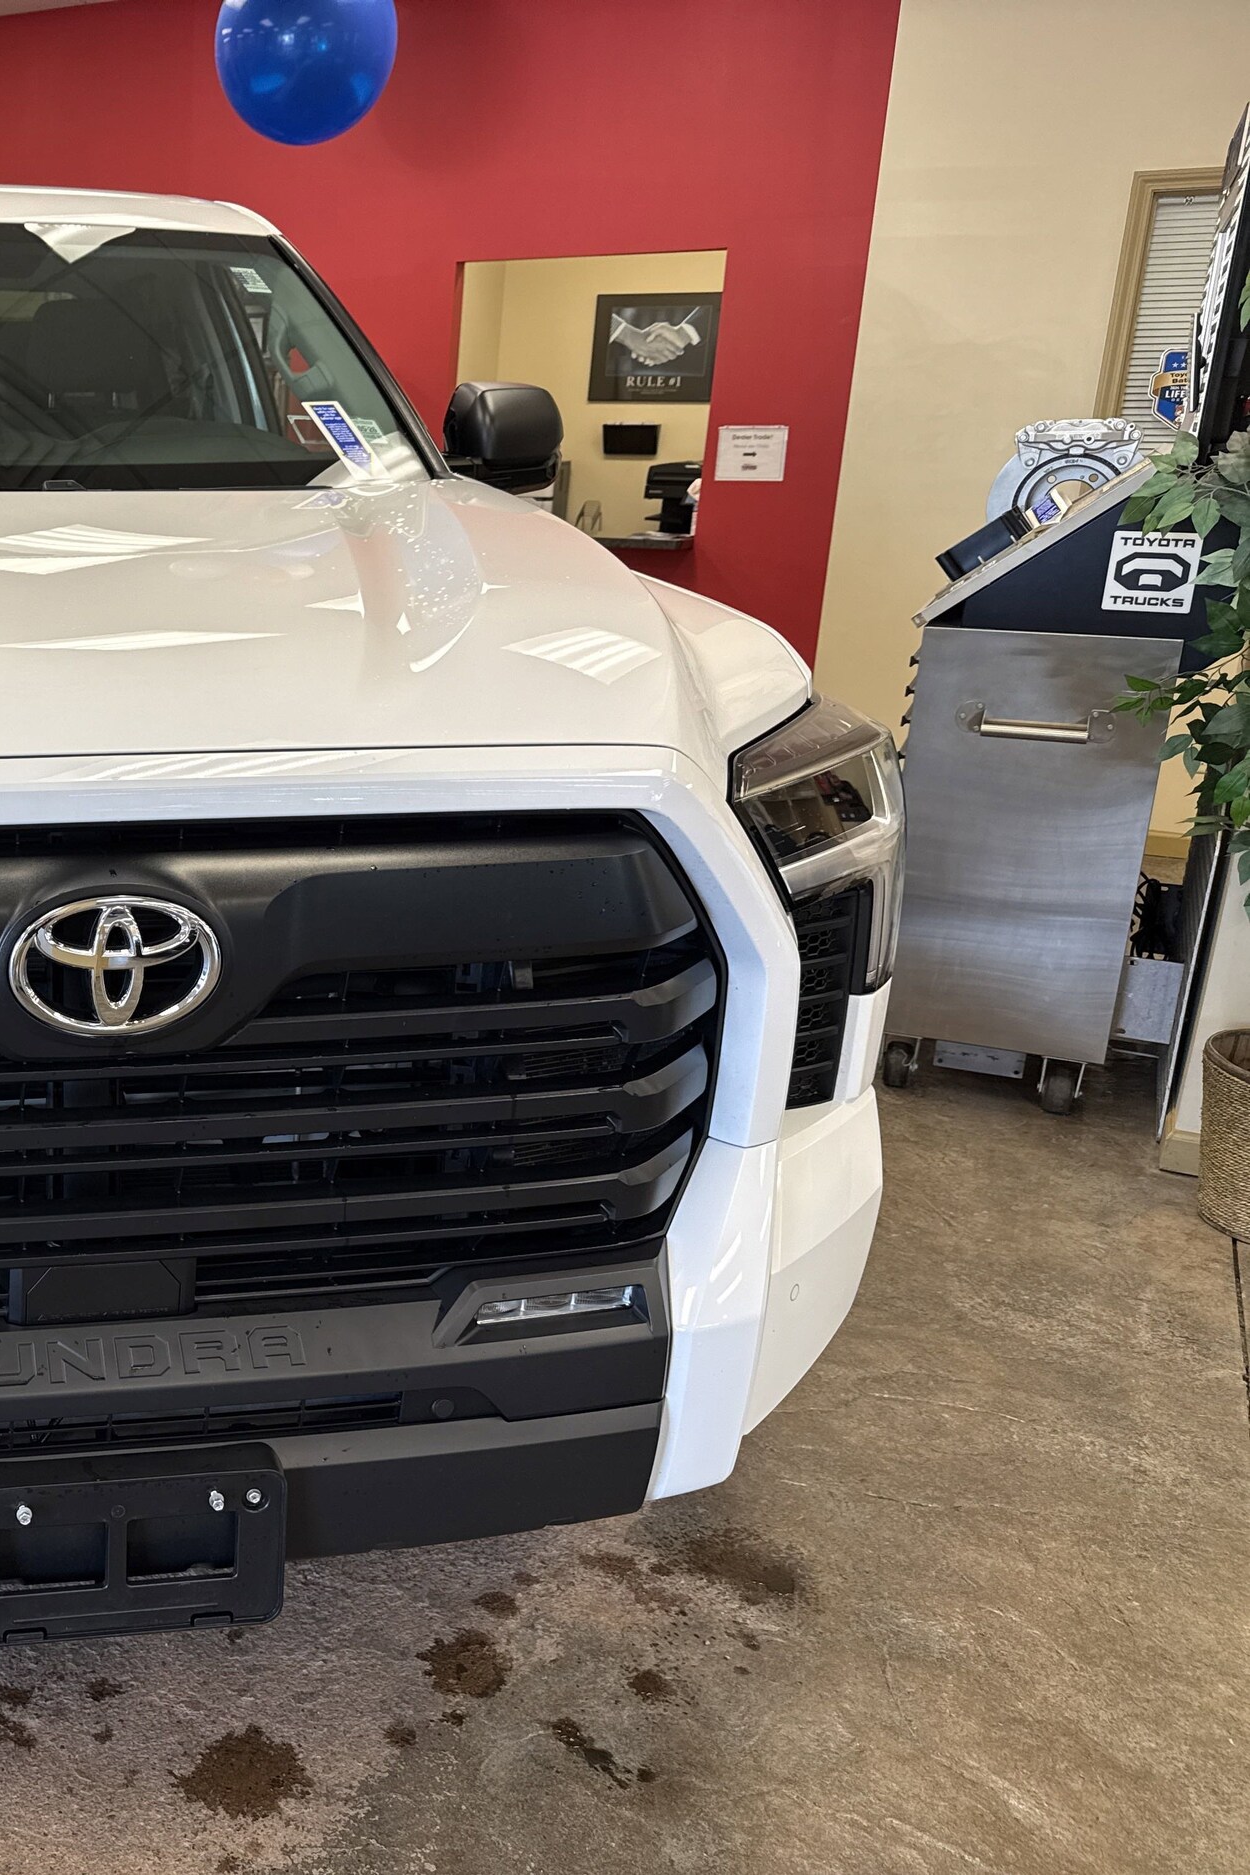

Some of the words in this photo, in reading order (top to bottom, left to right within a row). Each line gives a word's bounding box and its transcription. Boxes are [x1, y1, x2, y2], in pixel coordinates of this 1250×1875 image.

[626, 376, 665, 387] RULE
[669, 376, 681, 387] #1
[1120, 537, 1196, 548] TOYOTA
[1110, 595, 1185, 608] TRUCKS
